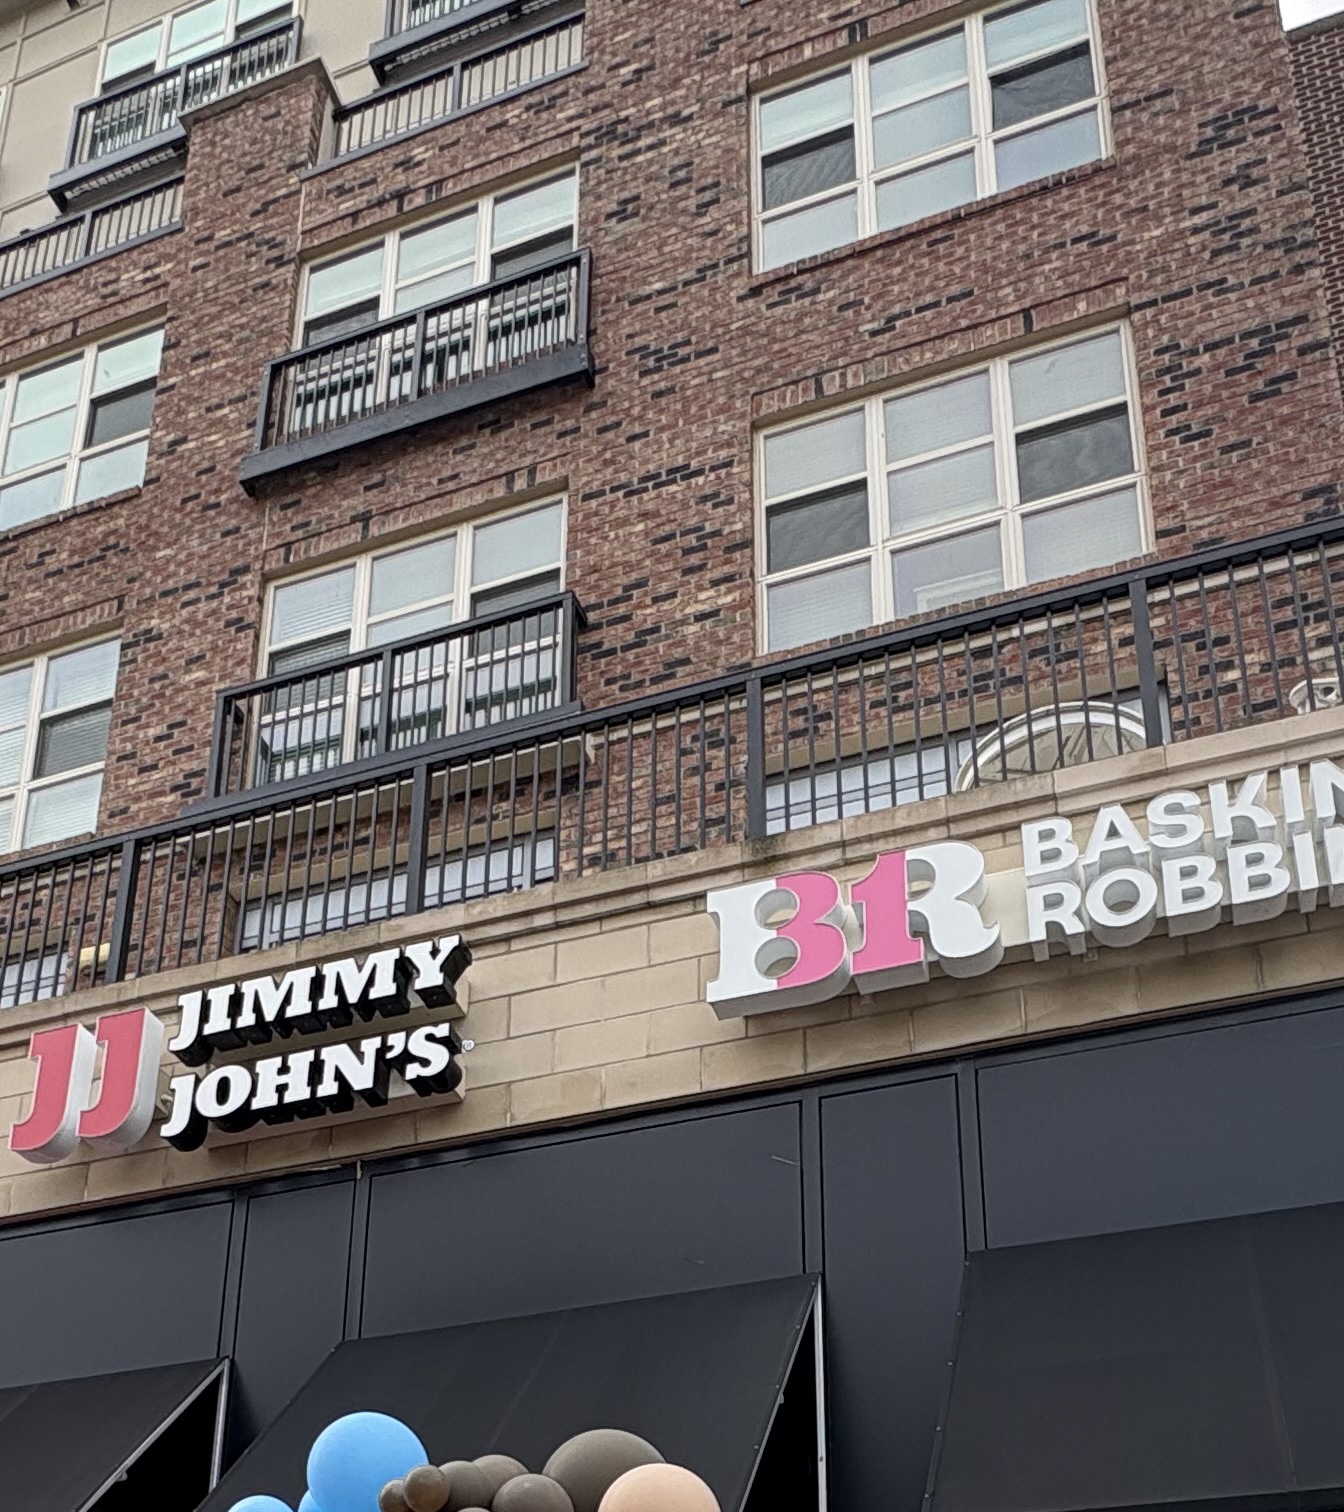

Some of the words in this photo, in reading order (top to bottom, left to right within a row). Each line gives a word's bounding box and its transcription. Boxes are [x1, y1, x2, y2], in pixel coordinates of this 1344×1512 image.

[706, 841, 1002, 1012] BR
[169, 935, 464, 1056] JIMMY
[9, 1006, 156, 1158] JJ
[160, 1023, 452, 1142] JOHN'S
